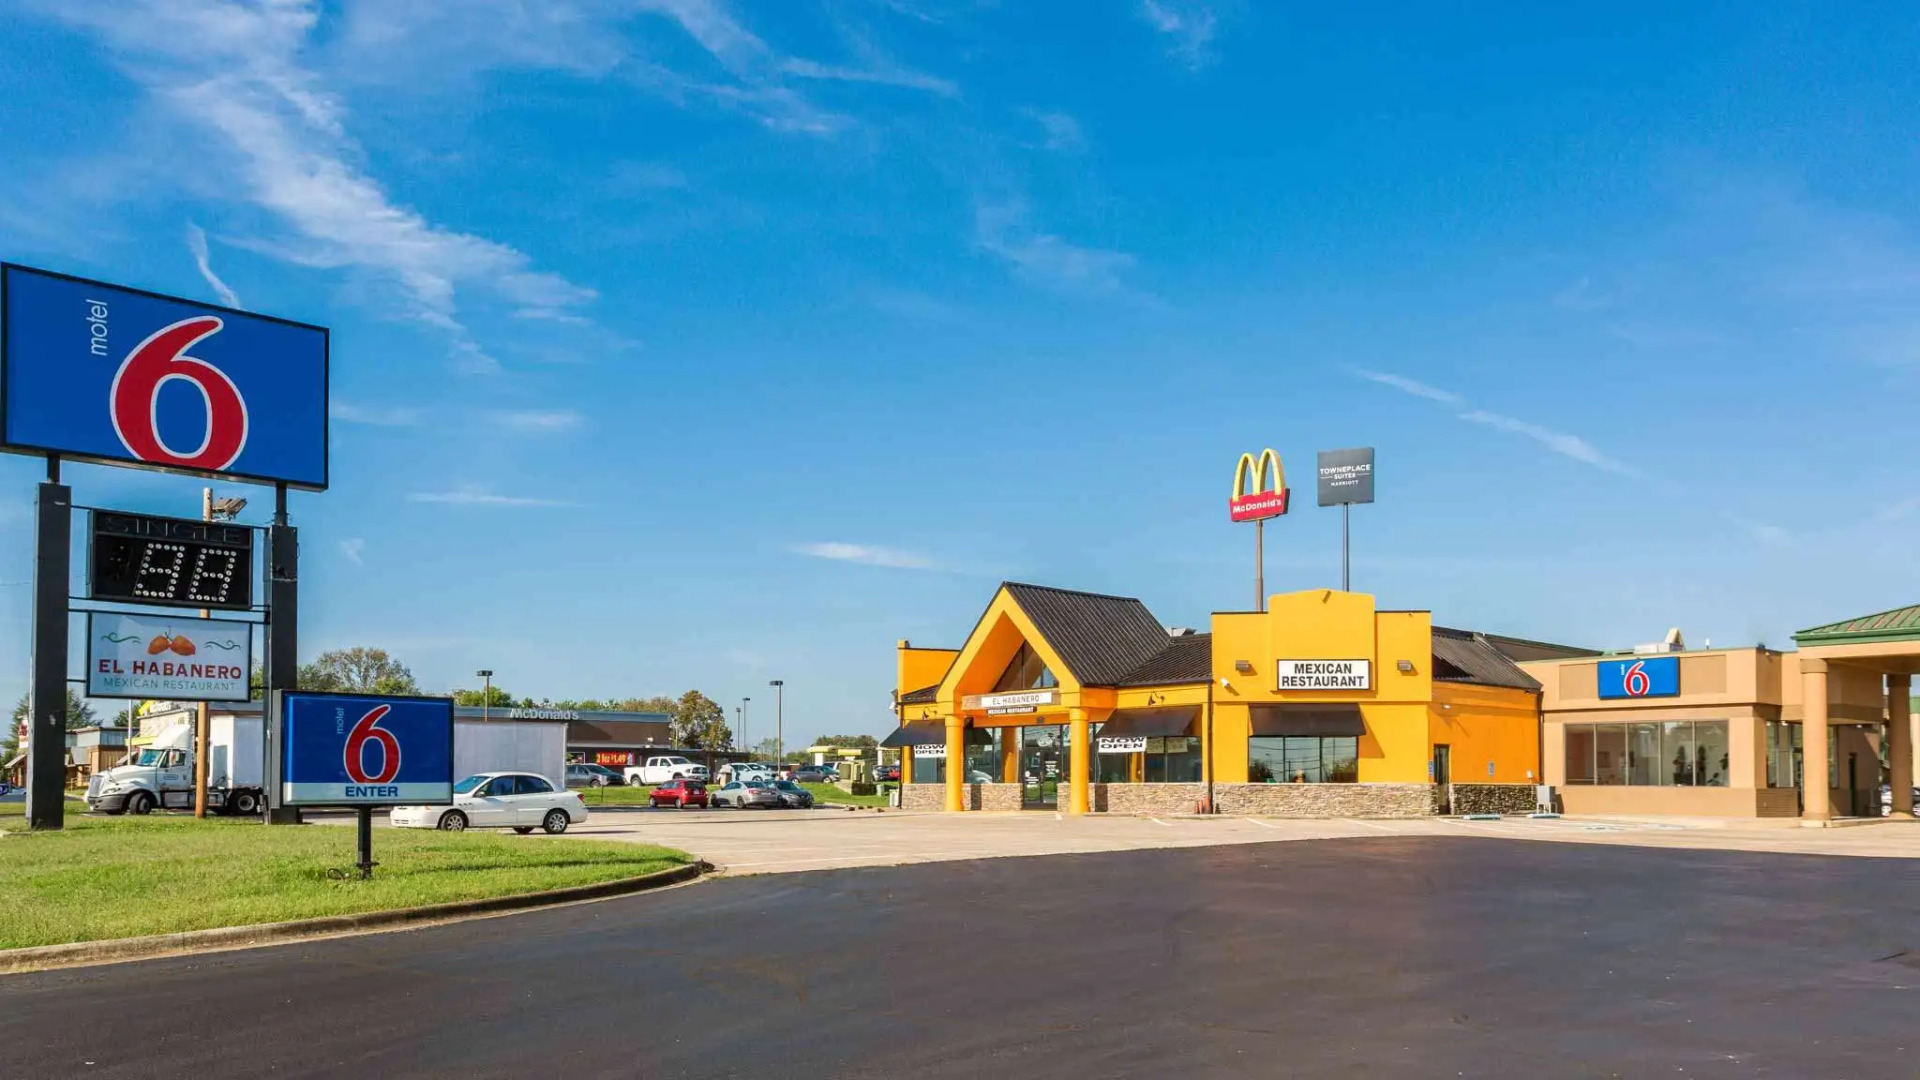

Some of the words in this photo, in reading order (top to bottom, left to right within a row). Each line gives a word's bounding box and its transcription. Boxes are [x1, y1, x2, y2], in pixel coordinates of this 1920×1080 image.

[86, 299, 108, 356] motel
[109, 315, 249, 471] 6
[1319, 463, 1371, 475] TOWNEPLACE
[1333, 472, 1356, 480] SUITES
[1232, 498, 1282, 514] McDonald's
[106, 515, 242, 544] SINGLE
[98, 658, 124, 674] EL
[132, 660, 242, 680] HABANERO
[1294, 663, 1352, 675] MEXICAN
[103, 677, 158, 689] MEXICAN
[163, 679, 237, 692] RESTAURANT
[1281, 675, 1365, 687] RESTAURANT
[1623, 660, 1650, 697] 6
[992, 697, 1001, 706] EL
[1002, 694, 1040, 705] HABANERO
[509, 707, 579, 720] McDonald's
[335, 707, 345, 735] motel
[343, 703, 401, 784] 6
[345, 785, 399, 798] ENTER
